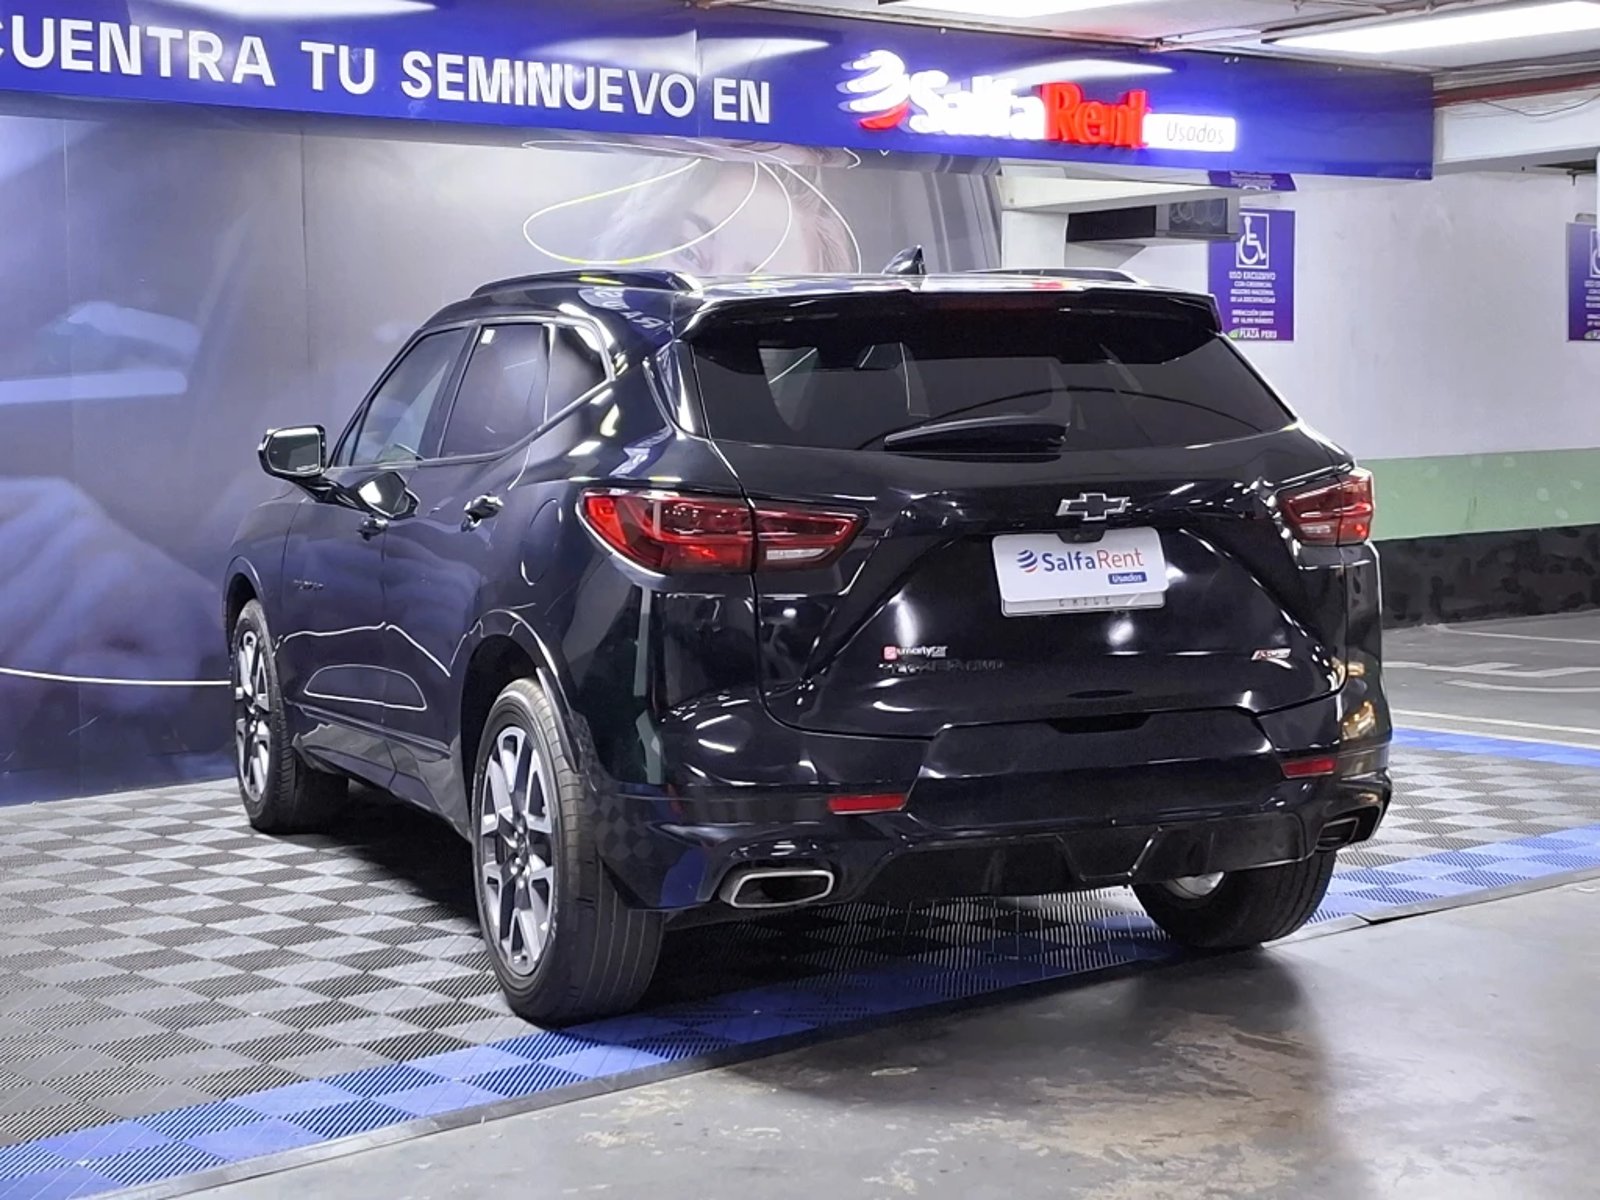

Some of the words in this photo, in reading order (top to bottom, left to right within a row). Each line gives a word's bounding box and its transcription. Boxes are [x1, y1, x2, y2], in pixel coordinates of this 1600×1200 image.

[0, 15, 276, 87] UENTRA
[300, 40, 375, 95] TU
[400, 50, 695, 118] SEMINUEVO
[712, 77, 771, 124] EN
[1166, 119, 1225, 144] Usados
[1041, 547, 1145, 573] SalfaRent
